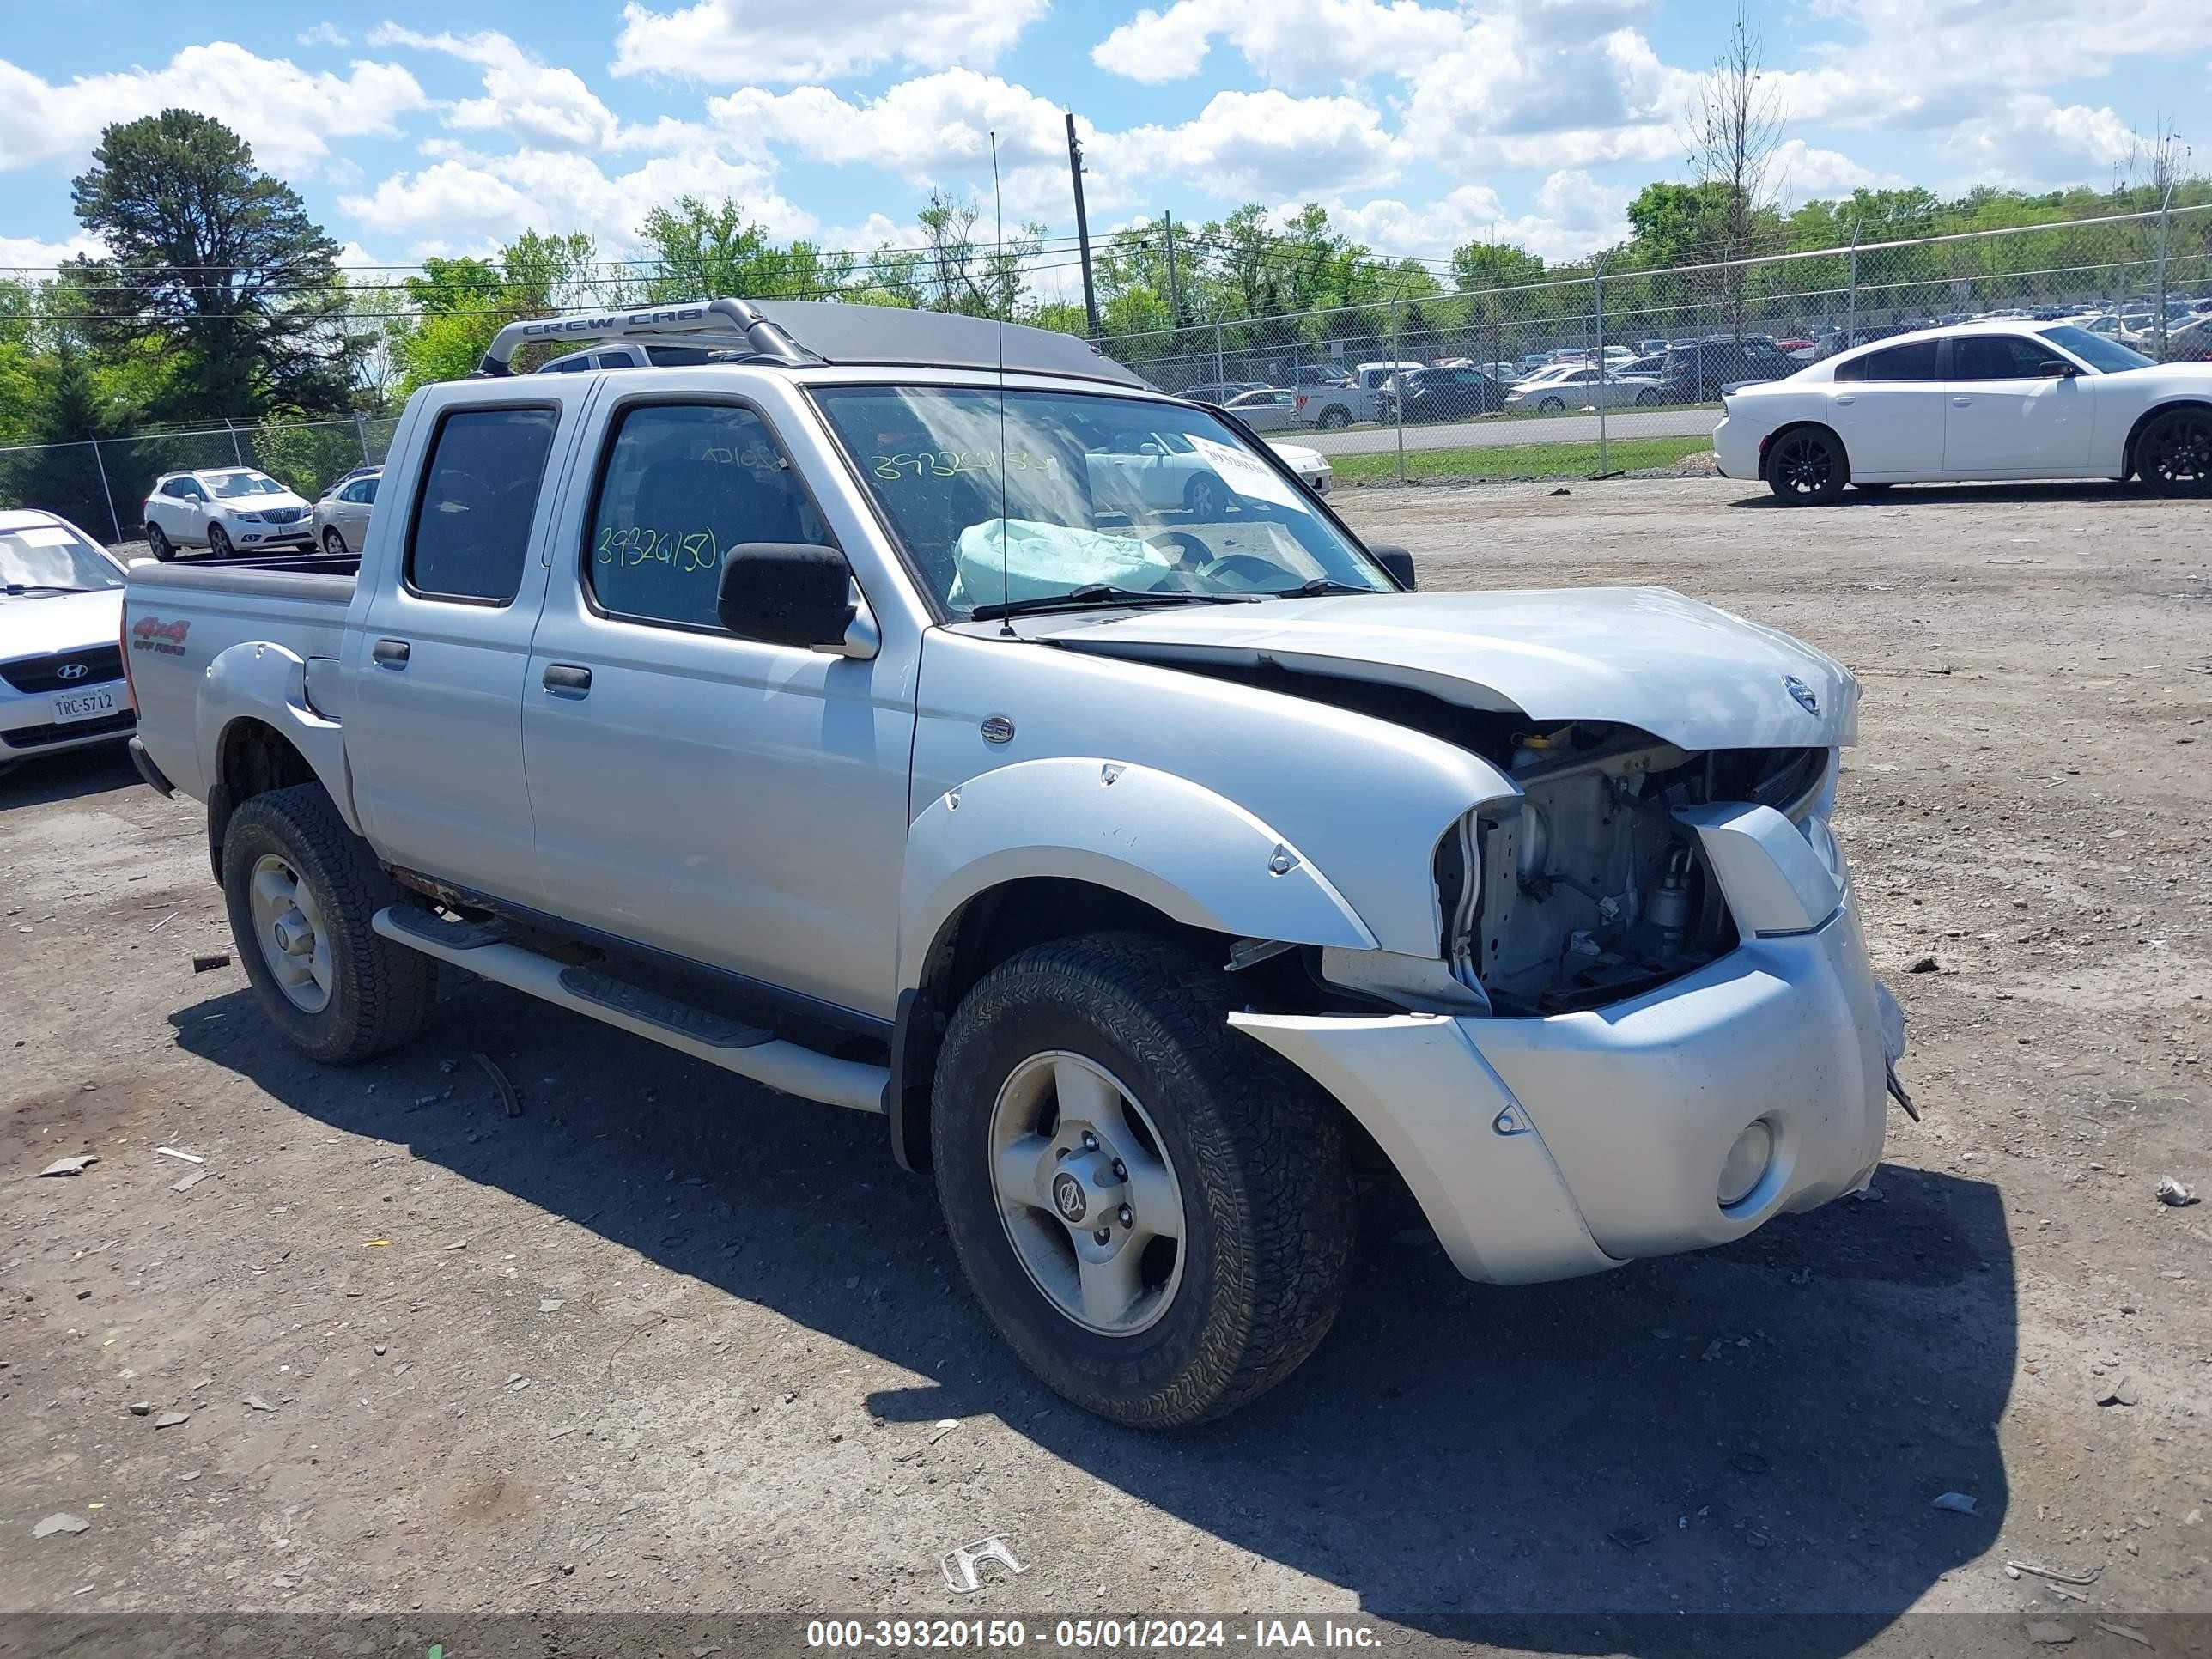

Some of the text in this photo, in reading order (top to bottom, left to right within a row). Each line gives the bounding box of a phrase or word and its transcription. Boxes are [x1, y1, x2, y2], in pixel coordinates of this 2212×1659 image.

[522, 308, 702, 336] CREW CAB
[55, 694, 113, 715] TRC-5712
